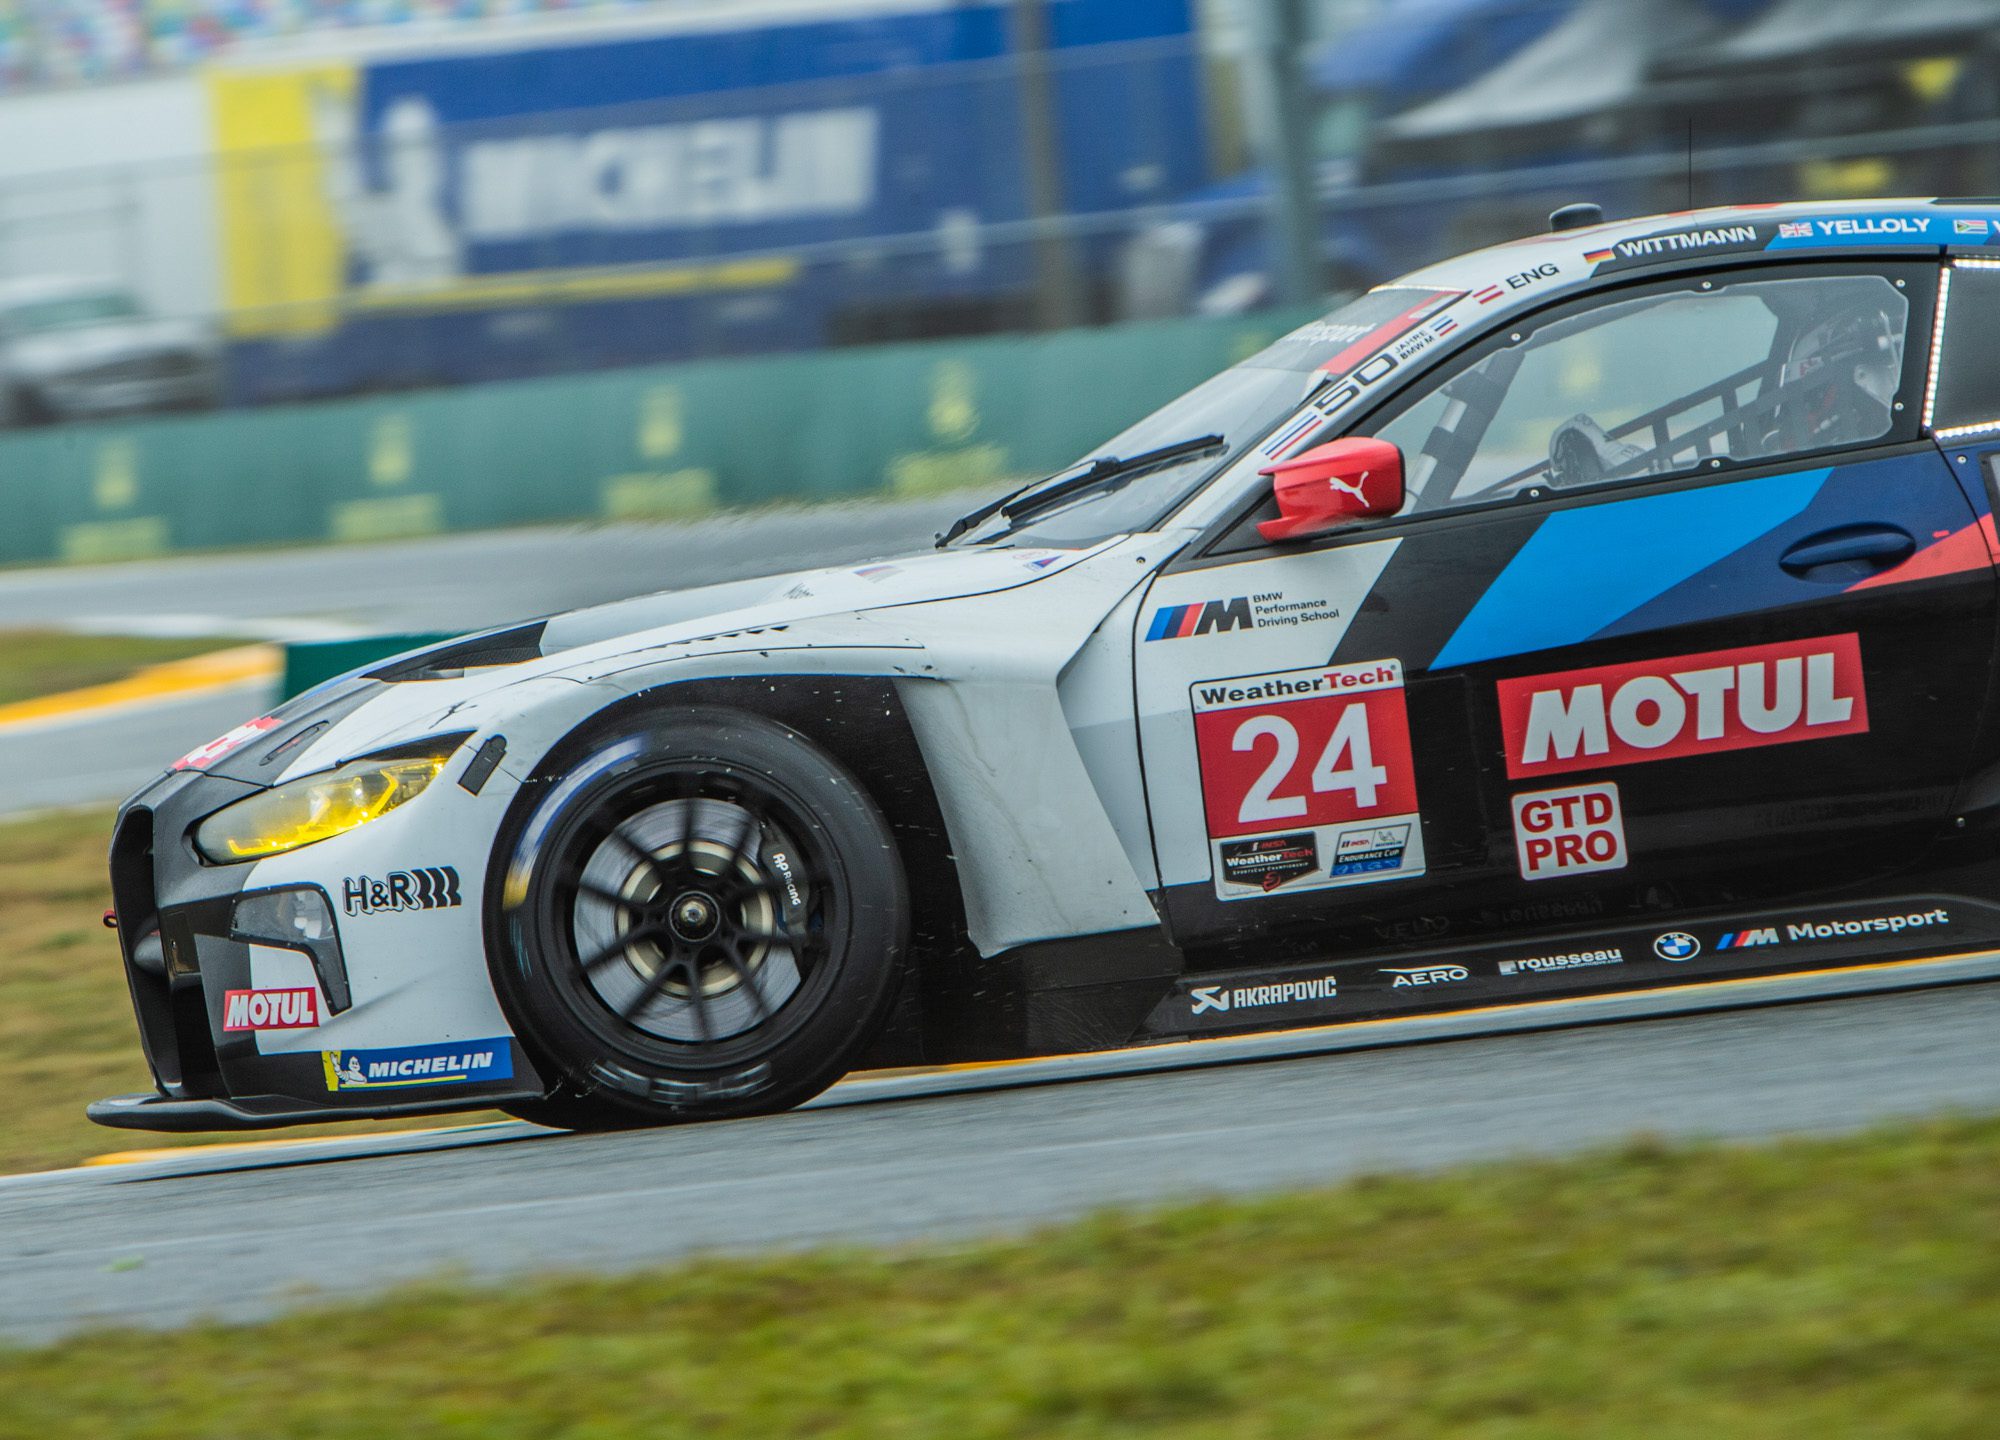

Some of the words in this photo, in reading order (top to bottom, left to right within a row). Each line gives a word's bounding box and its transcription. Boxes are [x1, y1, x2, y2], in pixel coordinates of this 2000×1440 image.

[1617, 226, 1757, 257] WITTMANN
[1817, 218, 1931, 235] YELLOLY
[1505, 263, 1560, 290] ENG
[1400, 341, 1425, 360] BMW
[1313, 353, 1399, 416] 50
[1253, 591, 1283, 603] BMW
[1255, 599, 1327, 614] Performance
[1194, 597, 1253, 636] M
[1257, 614, 1299, 628] Driving
[1300, 609, 1340, 623] School
[1200, 667, 1395, 705] WeatherTech
[1522, 652, 1854, 764] MOTUL
[1231, 702, 1388, 823] 24
[1520, 792, 1614, 833] GTD
[1226, 848, 1314, 867] WeatherTech
[1525, 830, 1618, 871] PRO
[343, 871, 420, 916] H&R
[1787, 908, 1949, 940] Motorsport
[1517, 949, 1622, 970] rousseau
[1233, 976, 1337, 1008] AKRAPOVIČ
[1392, 968, 1469, 988] AERO
[226, 991, 314, 1028] MOTUL
[368, 1052, 494, 1078] MICHELIN
